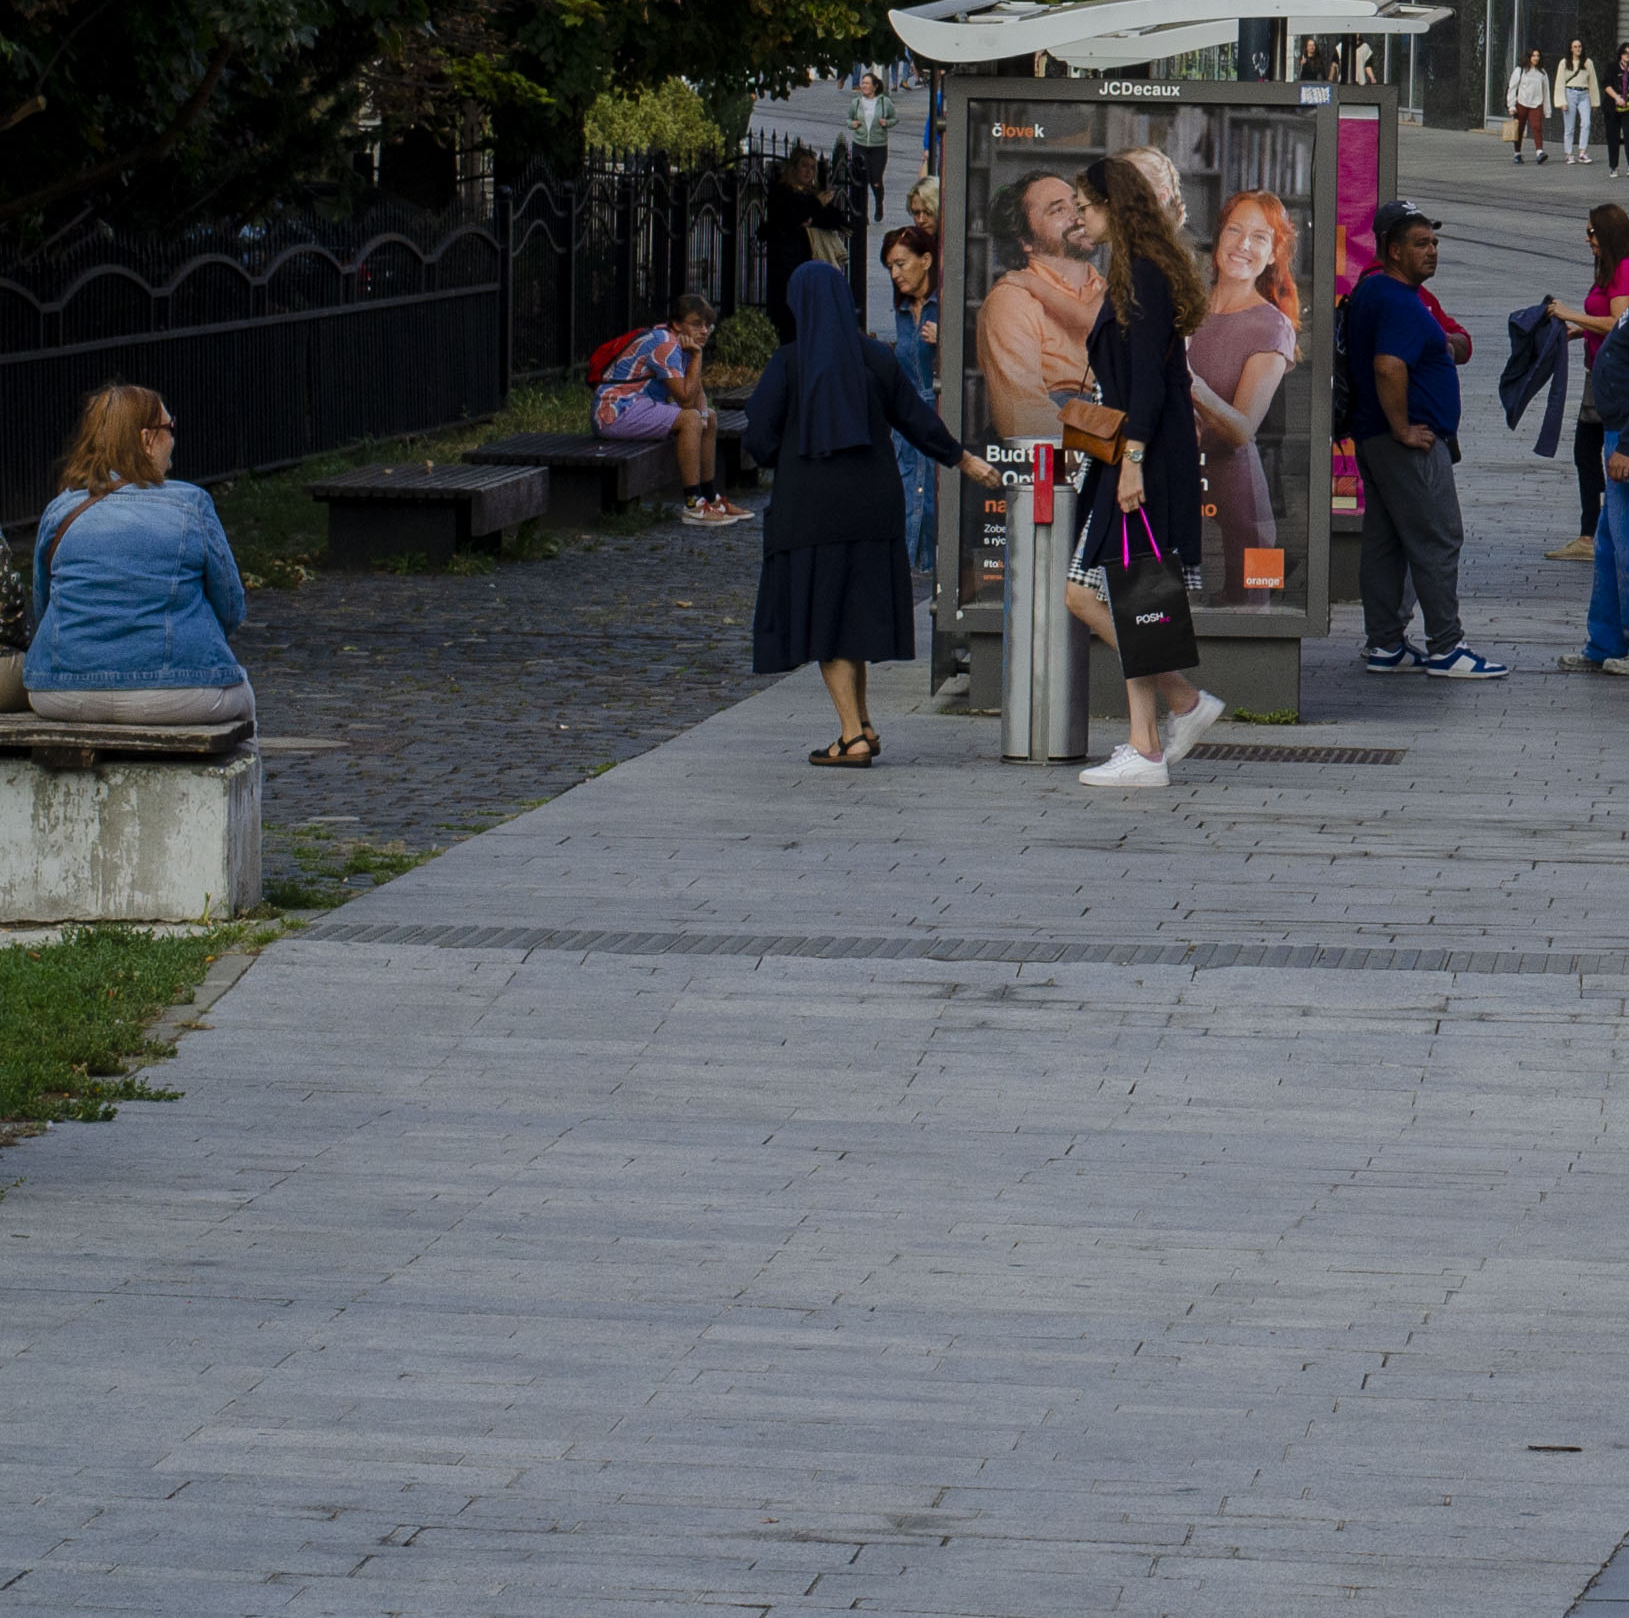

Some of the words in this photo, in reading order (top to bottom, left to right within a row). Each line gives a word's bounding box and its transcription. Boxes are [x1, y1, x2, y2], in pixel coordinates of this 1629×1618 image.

[1099, 81, 1181, 96] JCDecaux
[991, 122, 1044, 138] človek
[1245, 577, 1281, 588] orange
